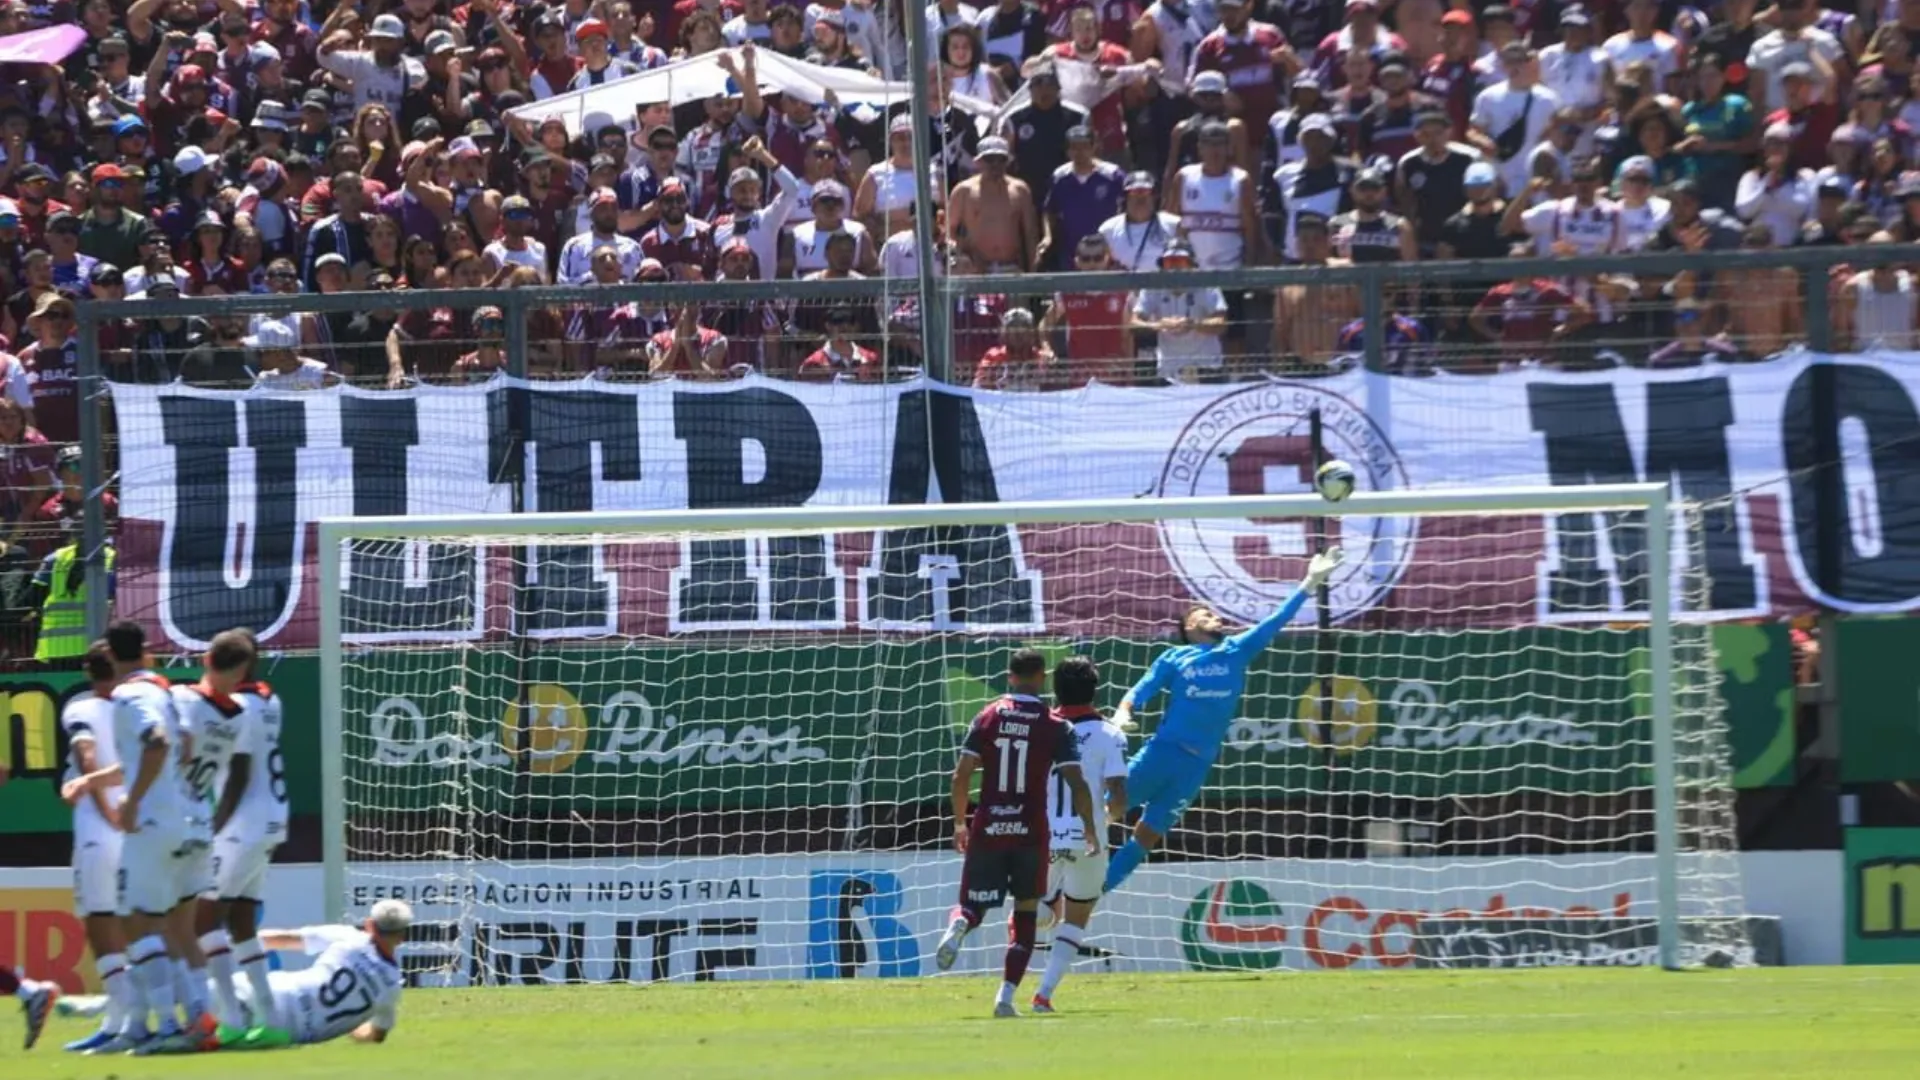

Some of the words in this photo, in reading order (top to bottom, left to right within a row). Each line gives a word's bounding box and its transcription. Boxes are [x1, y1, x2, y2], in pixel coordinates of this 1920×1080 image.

[1171, 388, 1284, 483] DEPORTIVO
[157, 386, 1045, 650] ULTRA
[592, 690, 828, 767] Pinos
[1380, 682, 1598, 749] Pinos
[993, 737, 1029, 794] 11
[353, 882, 571, 906] EFRIGERACION
[587, 878, 761, 900] INDUSTRIAL
[968, 889, 1000, 902] RCA
[319, 967, 373, 1023] 97
